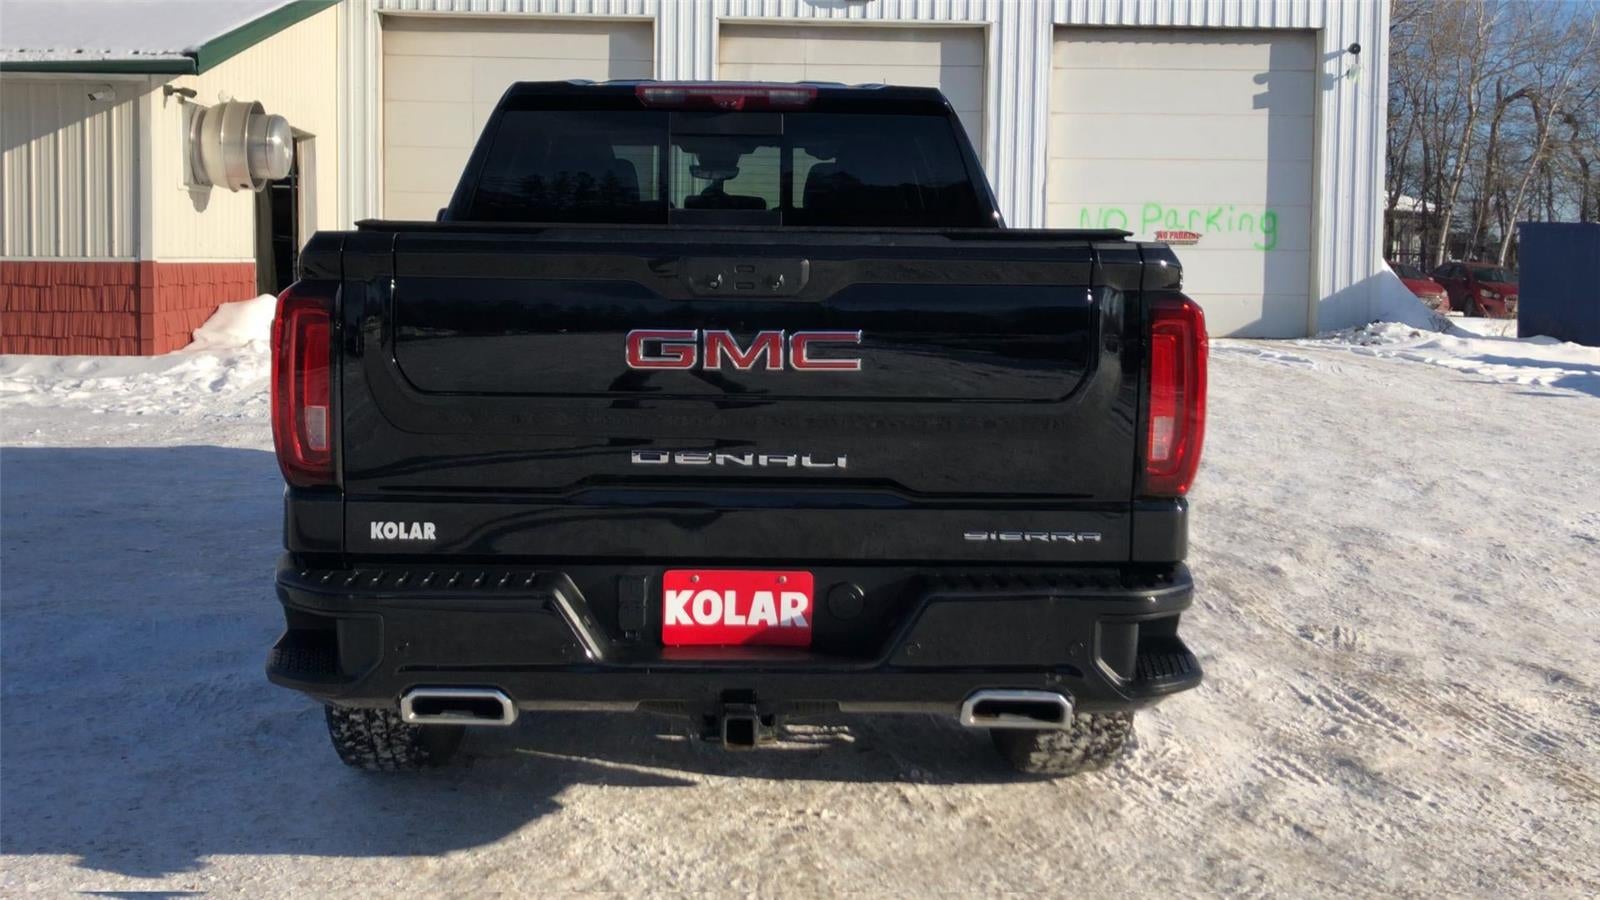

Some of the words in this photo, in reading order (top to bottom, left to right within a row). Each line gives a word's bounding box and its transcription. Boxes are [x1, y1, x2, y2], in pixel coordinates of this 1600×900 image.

[626, 329, 862, 370] GMC
[631, 451, 847, 468] DENALI
[370, 521, 436, 540] KOLAR
[964, 530, 1102, 543] SIERRA
[664, 589, 809, 627] KOLAR
